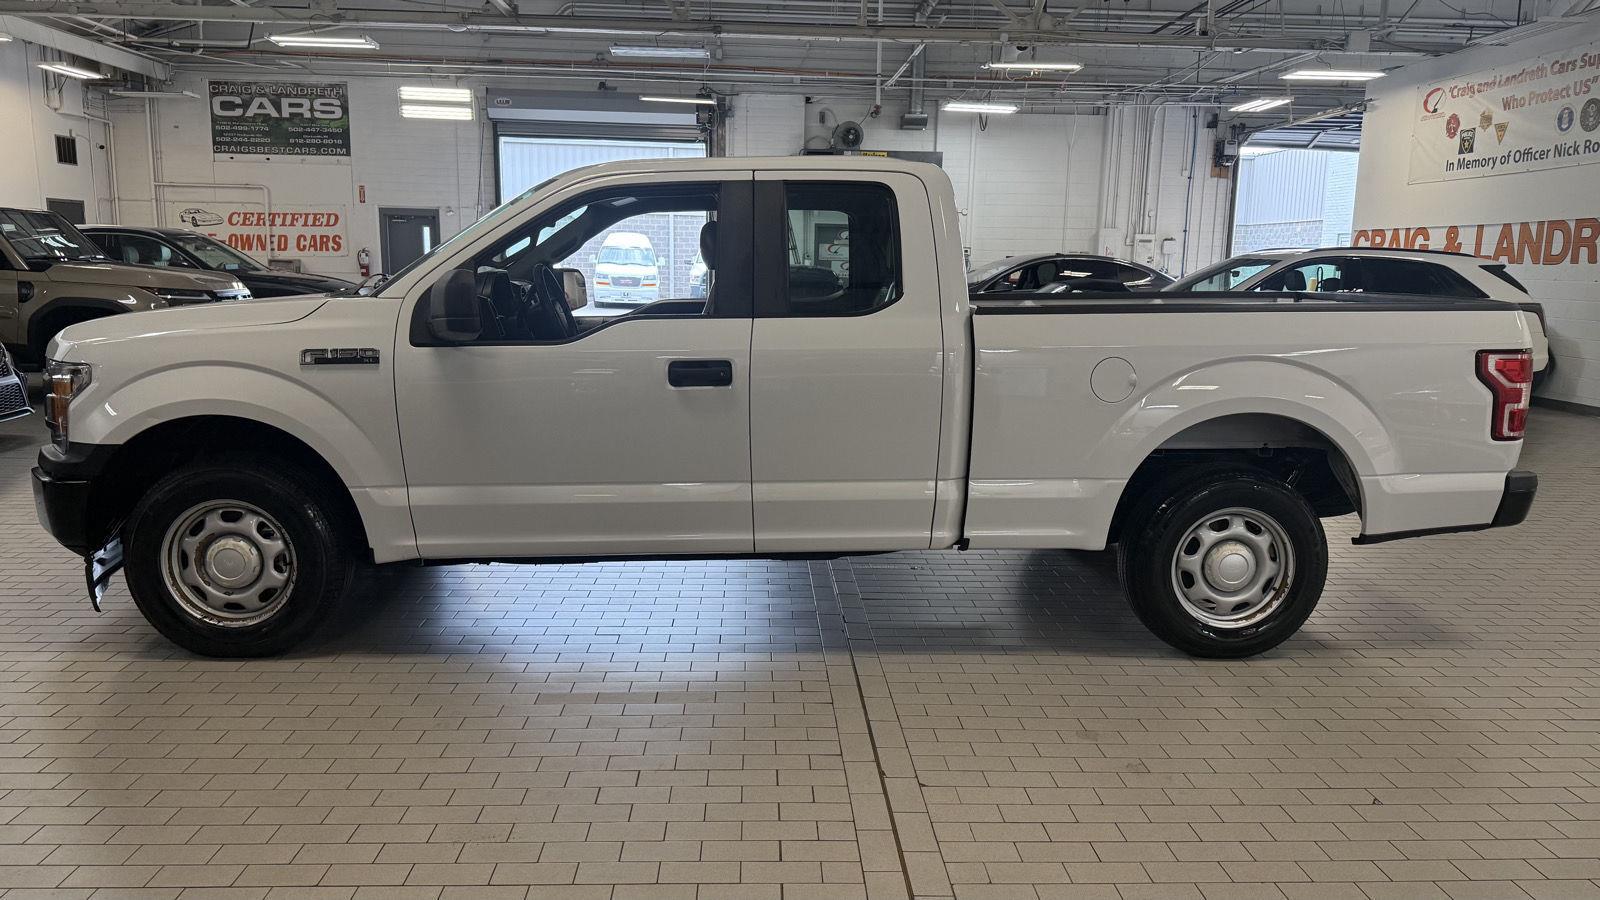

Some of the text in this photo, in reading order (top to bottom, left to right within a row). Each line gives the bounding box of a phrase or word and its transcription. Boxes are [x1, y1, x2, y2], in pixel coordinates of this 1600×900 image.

[1550, 59, 1578, 75] Cars
[209, 84, 343, 96] CRAIG & LANDRETH
[211, 95, 343, 119] CARS
[1502, 94, 1526, 111] Who
[213, 145, 347, 155] CRAIGSBESTCARS.COM
[1445, 139, 1600, 172] In Memory of Officer Nick Ro
[227, 211, 340, 227] CERTIFIED
[296, 234, 343, 252] CARS
[1443, 225, 1462, 253] &
[1474, 217, 1600, 266] LANDR
